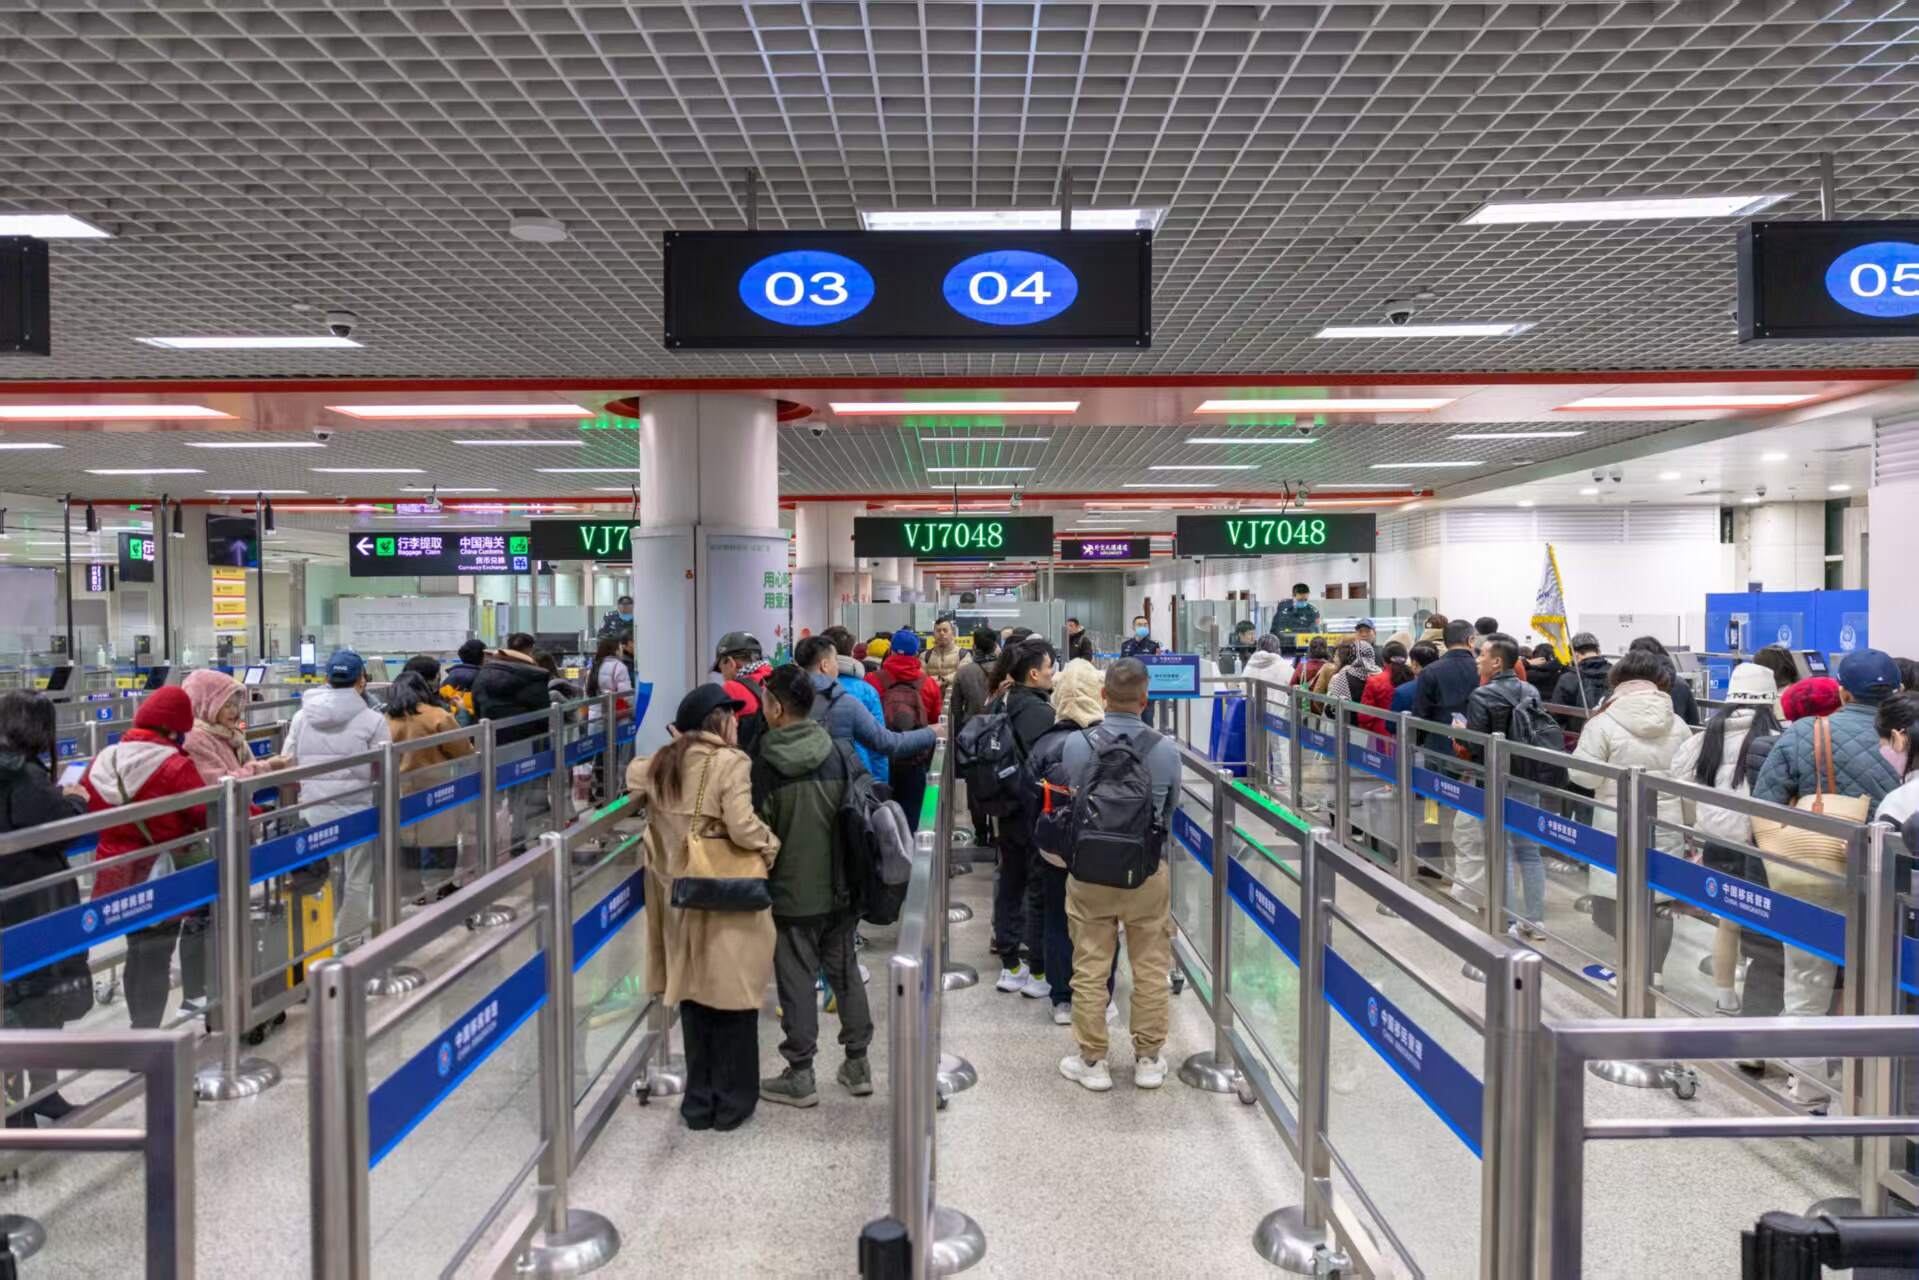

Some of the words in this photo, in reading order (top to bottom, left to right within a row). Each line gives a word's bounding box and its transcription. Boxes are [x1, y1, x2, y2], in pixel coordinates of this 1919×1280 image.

[764, 271, 849, 306] 03
[967, 271, 1052, 306] 04
[1850, 263, 1919, 297] 05
[397, 536, 442, 549] 行李提取
[460, 536, 505, 549] 中国海关
[579, 525, 640, 555] VJ7
[904, 523, 1003, 552] VJ7048
[1226, 519, 1326, 549] VJ7048
[398, 549, 422, 557] Baggage
[1722, 882, 1772, 911] 中国移民管理
[1381, 1009, 1422, 1061] 中国移民管理
